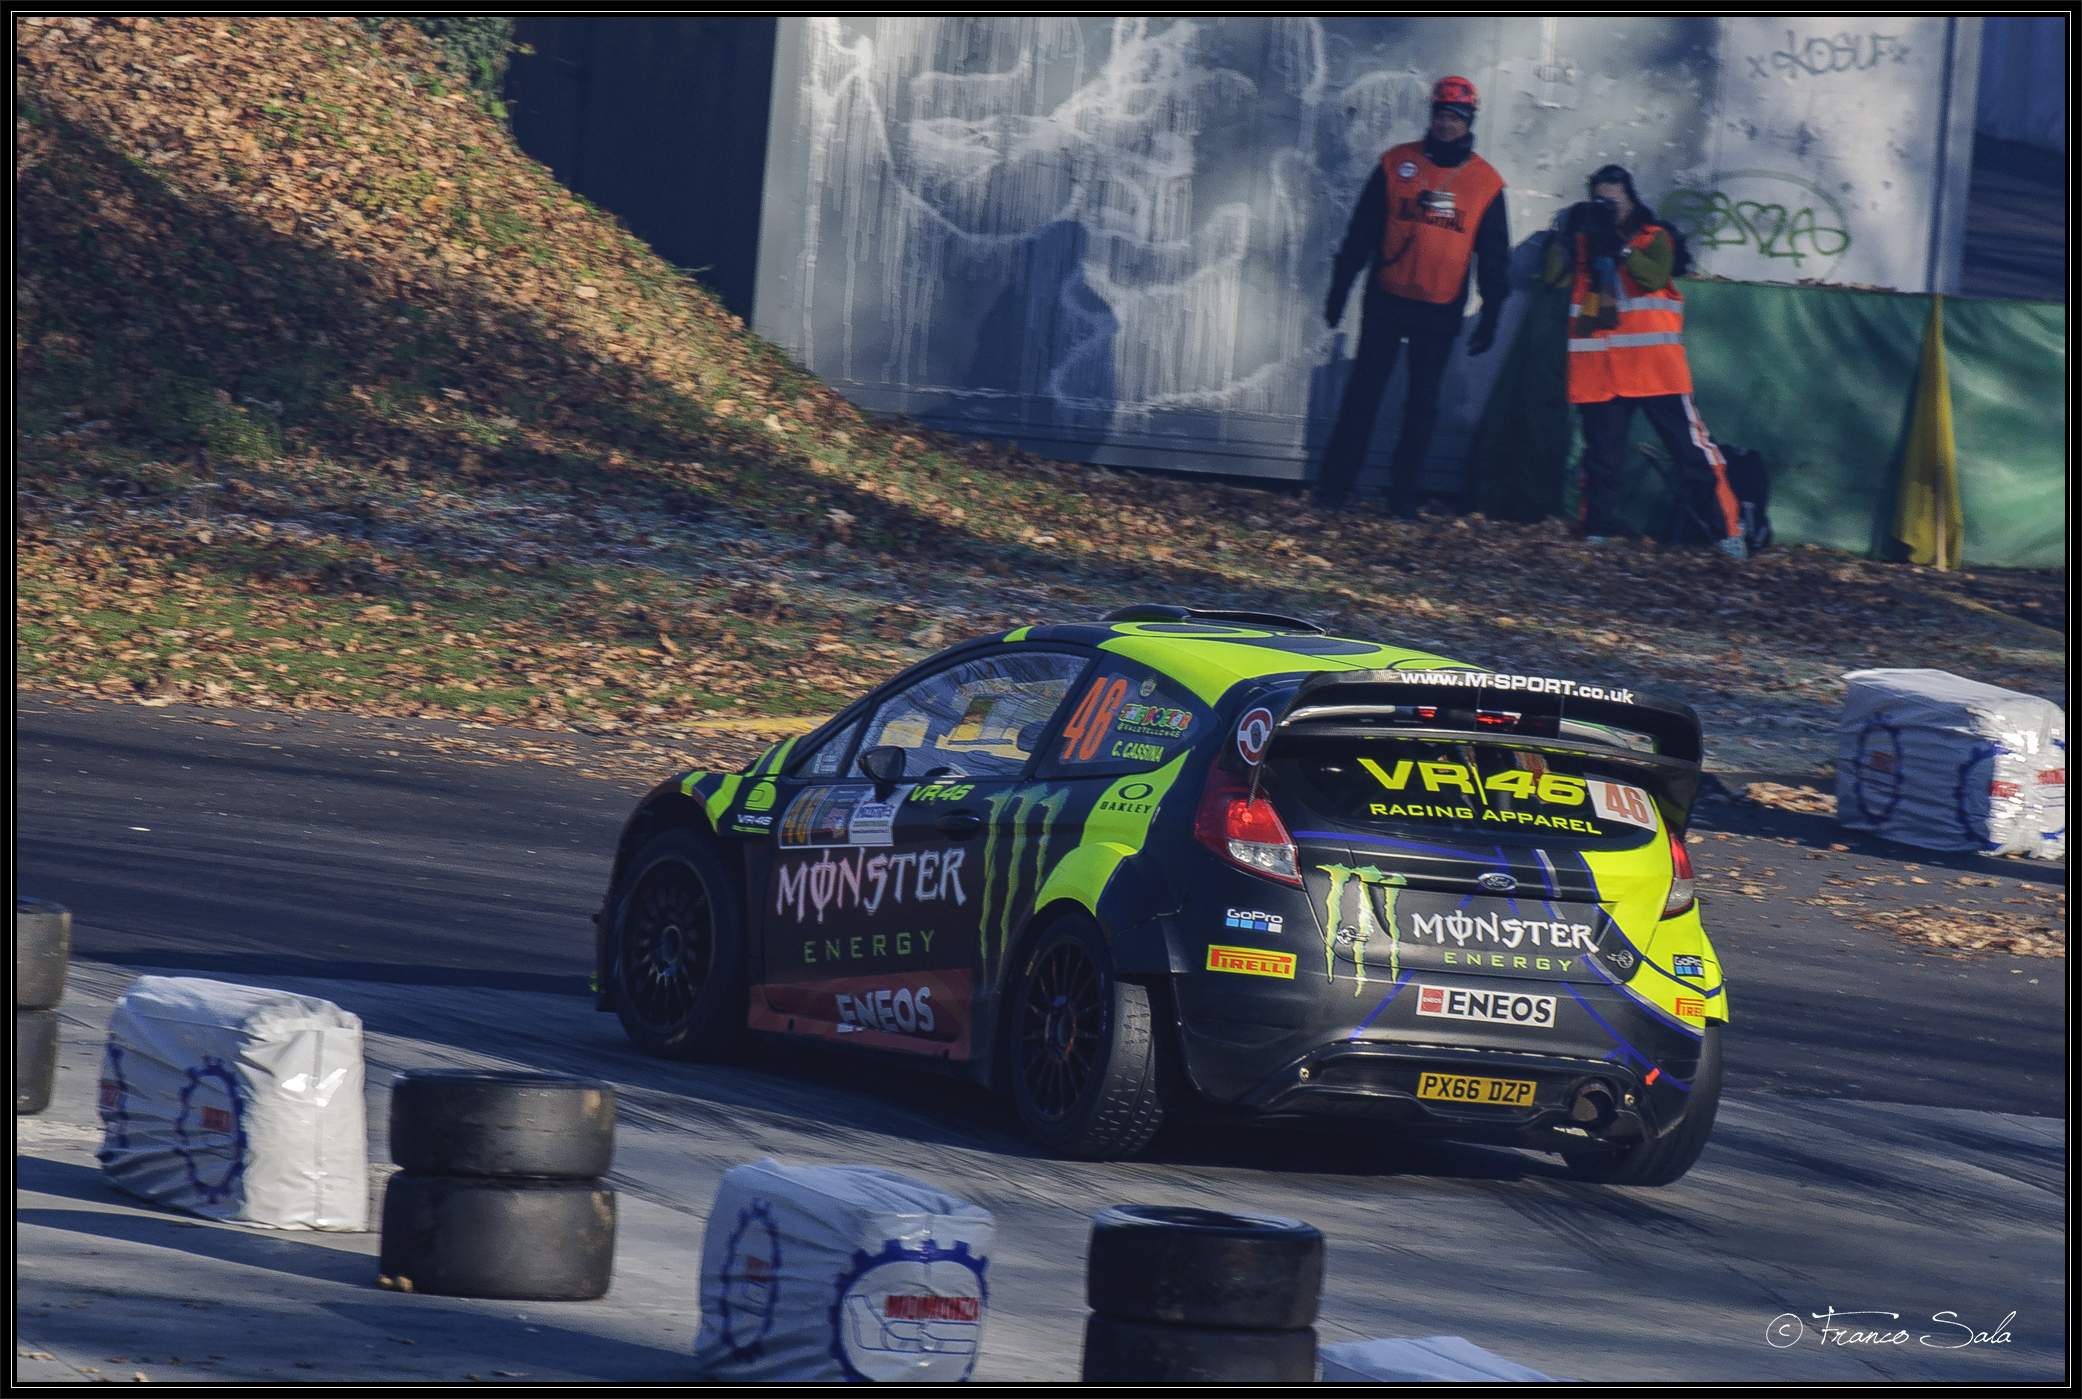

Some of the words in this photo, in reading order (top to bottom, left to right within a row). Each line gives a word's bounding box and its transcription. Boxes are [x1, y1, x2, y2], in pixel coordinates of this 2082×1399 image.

[1400, 672, 1634, 705] www.M-SPORT.co.uk
[1063, 676, 1128, 761] 46
[1099, 801, 1153, 814] OAKLEY
[1369, 803, 1473, 819] RACING
[1482, 809, 1602, 835] APPAREL
[1605, 781, 1650, 825] 46
[776, 847, 967, 924] MONSTER
[1226, 908, 1284, 924] GoPro
[1411, 910, 1600, 953] MONSTER
[804, 930, 935, 963] ENERGY
[1210, 949, 1292, 975] PIRELLI
[1444, 952, 1572, 972] ENERGY
[835, 986, 935, 1033] ENEOS
[1447, 990, 1552, 1024] ENEOS
[1423, 1076, 1481, 1100] PX66
[1488, 1081, 1531, 1103] DZP
